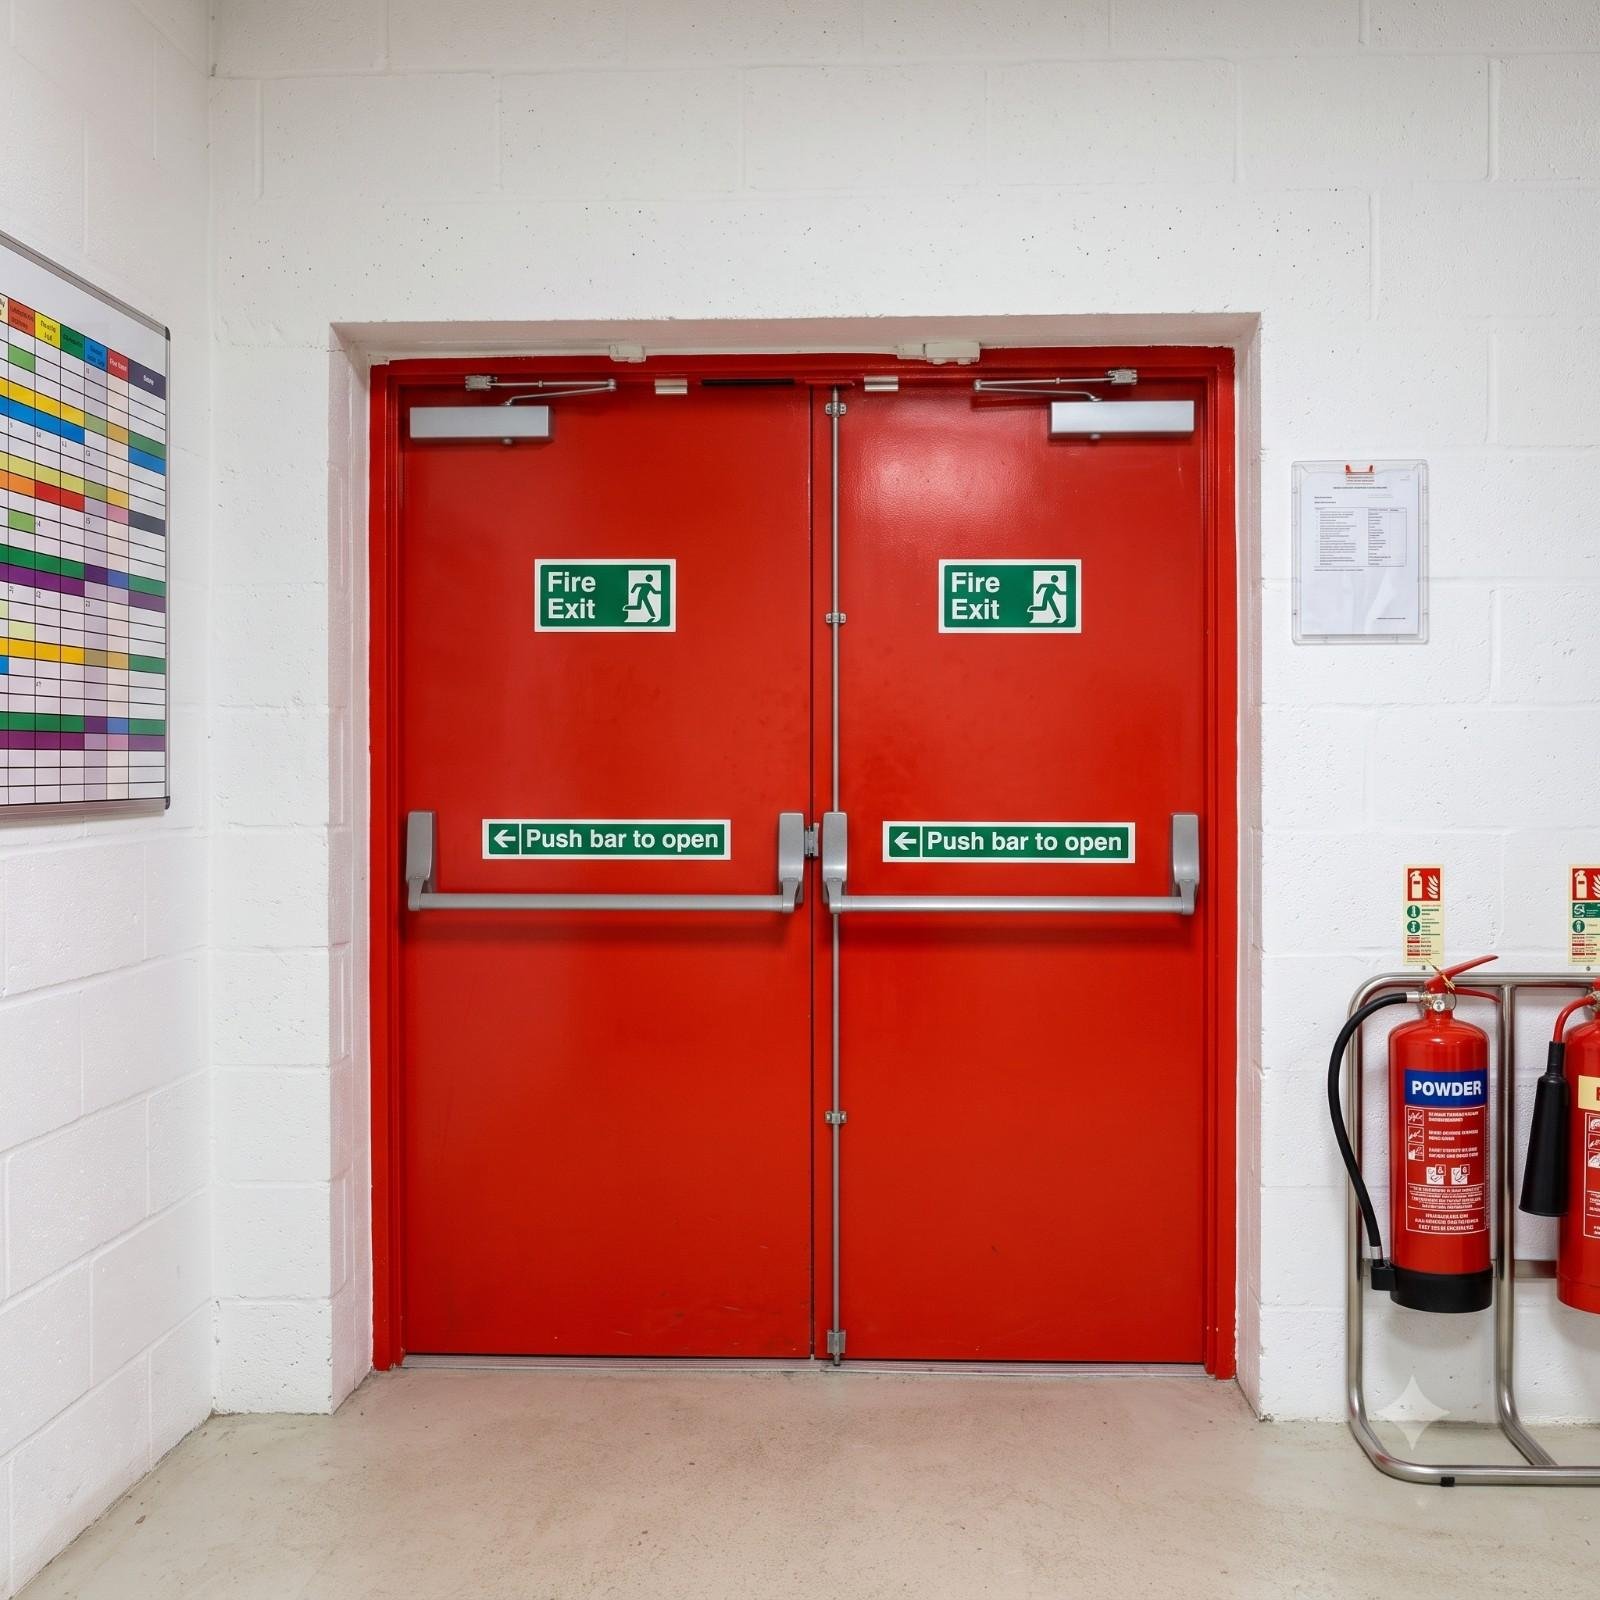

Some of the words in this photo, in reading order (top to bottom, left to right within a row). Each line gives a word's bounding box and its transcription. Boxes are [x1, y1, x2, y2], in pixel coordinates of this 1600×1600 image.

[548, 571, 596, 593] Fire
[951, 571, 1001, 593] Fire
[548, 598, 596, 619] Exit
[951, 598, 1000, 620] Exit
[526, 829, 582, 849] Push
[590, 829, 627, 849] bar
[633, 830, 656, 848] to
[662, 832, 718, 852] open
[927, 831, 984, 850] Push
[992, 831, 1029, 850] bar
[1035, 832, 1058, 850] to
[1065, 835, 1122, 855] open
[1411, 1080, 1482, 1097] POWDER
